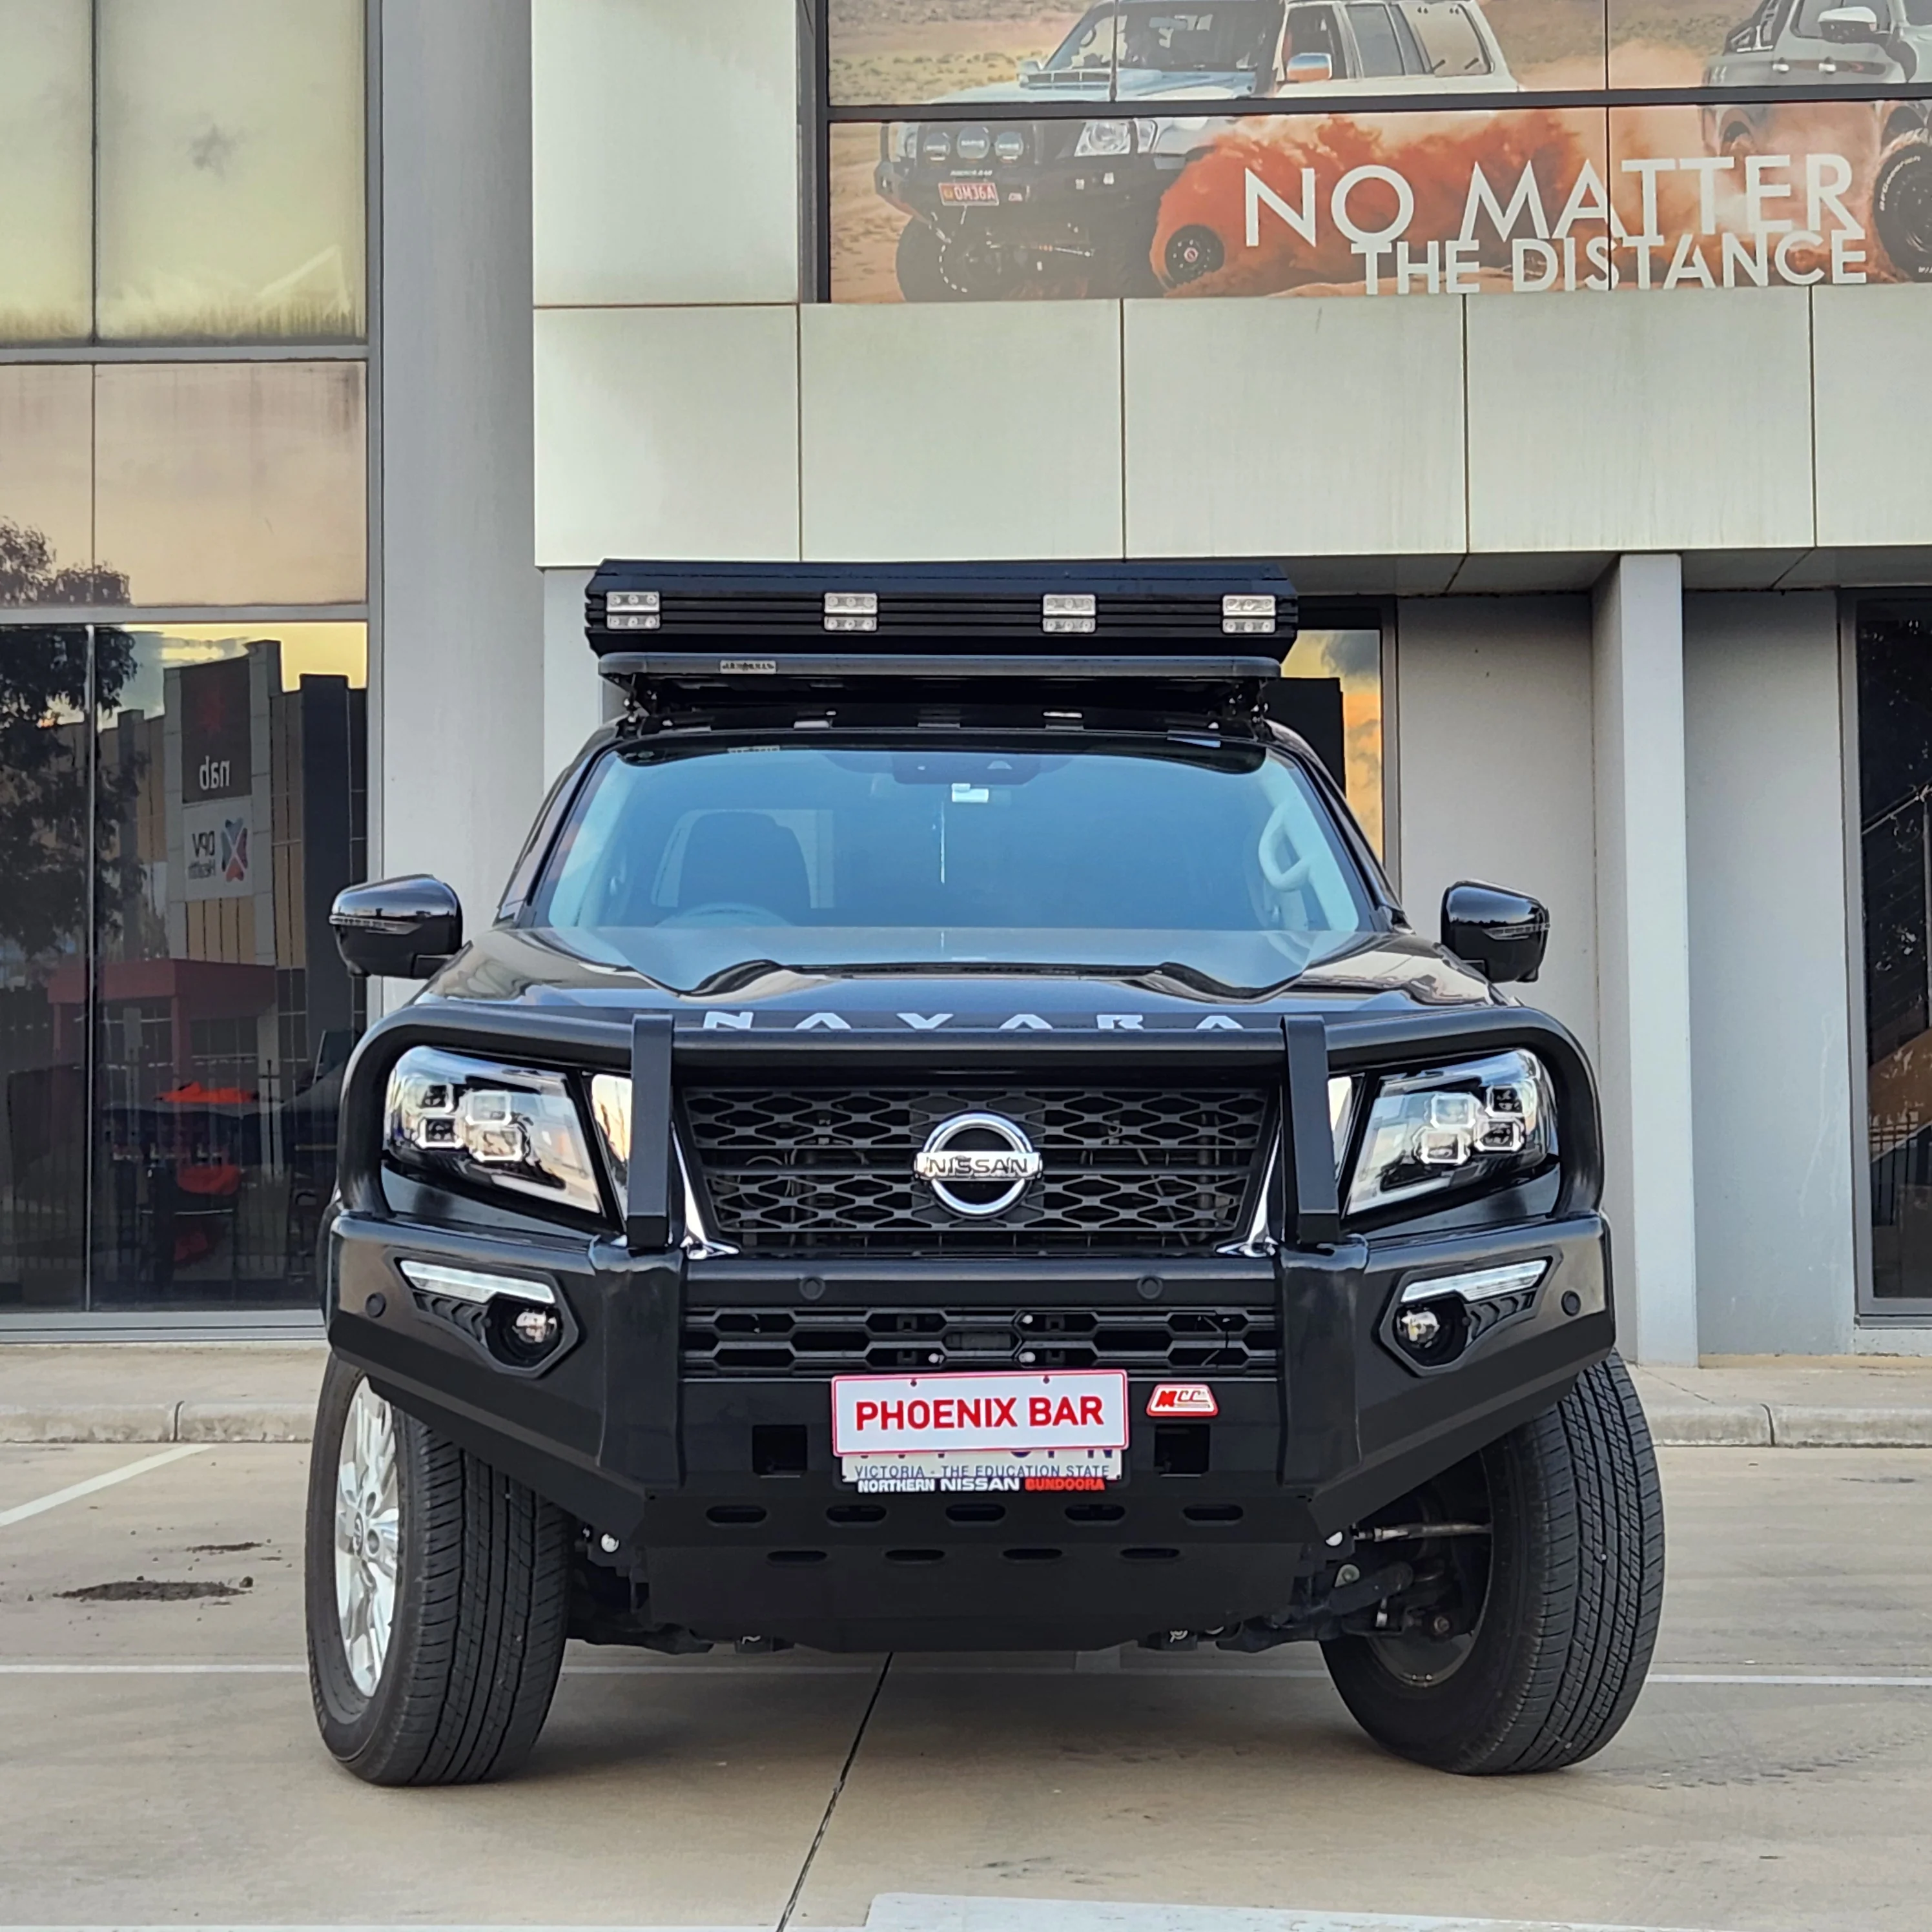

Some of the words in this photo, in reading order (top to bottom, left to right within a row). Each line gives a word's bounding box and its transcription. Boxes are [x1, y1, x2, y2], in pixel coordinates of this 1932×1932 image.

[1244, 165, 1414, 248] NO
[1459, 153, 1865, 243] MATTER
[1351, 240, 1481, 295] THE
[1512, 229, 1867, 293] DISTANCE
[703, 1011, 1244, 1030] NAVARA
[927, 1156, 1028, 1177] NISSAN
[1155, 1390, 1209, 1408] MCC
[856, 1397, 1018, 1430] PHOENIX
[1029, 1396, 1104, 1426] BAR
[854, 1465, 925, 1479] VICTORIA
[941, 1465, 969, 1478] THE
[976, 1464, 1060, 1477] EDUCATION
[1066, 1464, 1109, 1477] STATE
[858, 1478, 936, 1493] NORTHERN
[940, 1478, 1020, 1492] NISSAN
[1024, 1477, 1105, 1491] BUNDOORA
